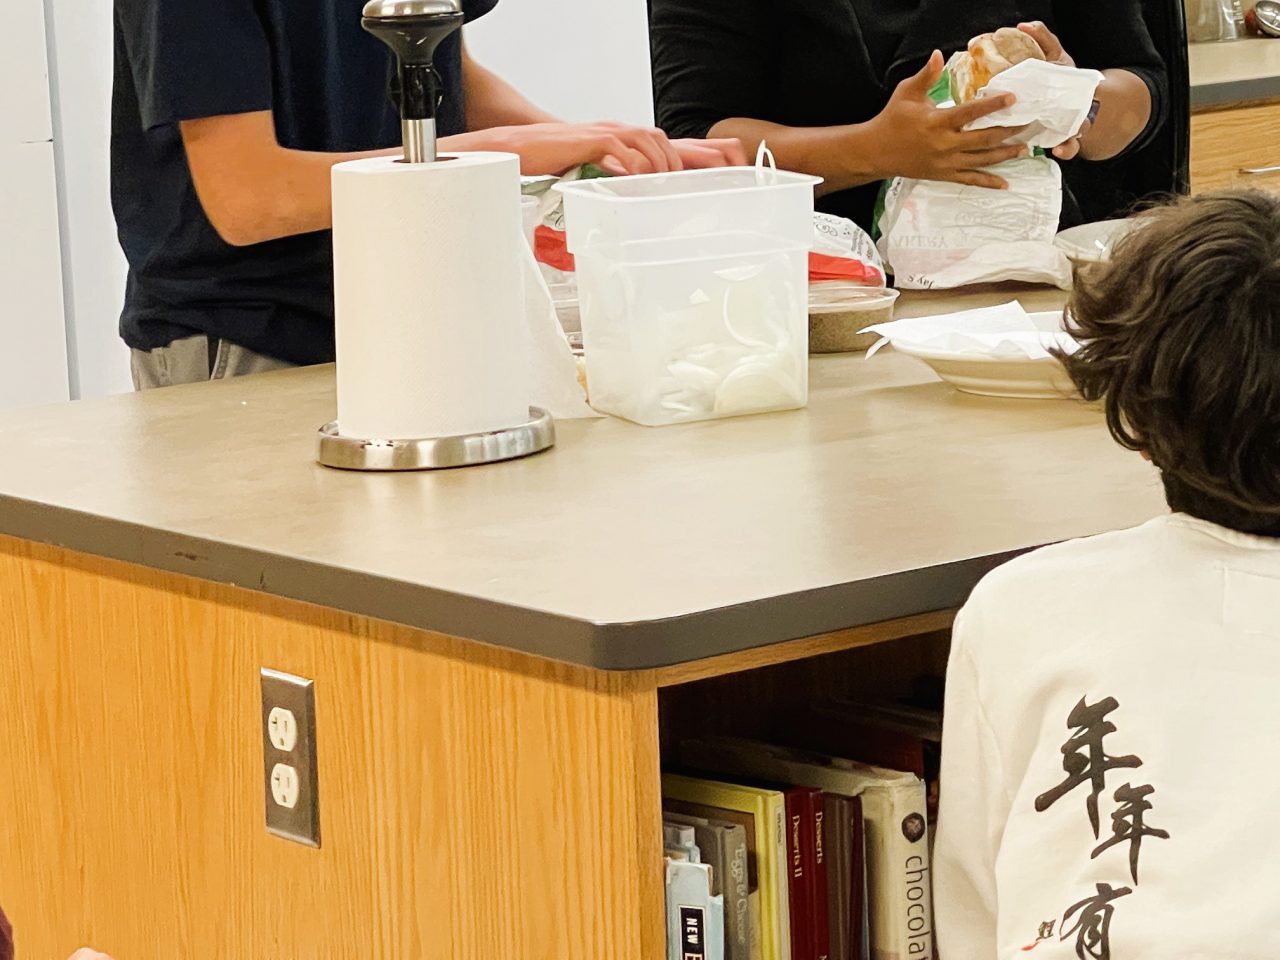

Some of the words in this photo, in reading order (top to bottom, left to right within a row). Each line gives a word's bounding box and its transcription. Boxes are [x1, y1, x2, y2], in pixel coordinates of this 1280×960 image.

[791, 814, 803, 866] Desserts
[814, 811, 824, 865] Desserts
[685, 917, 699, 945] NEW
[904, 855, 931, 960] chocola
